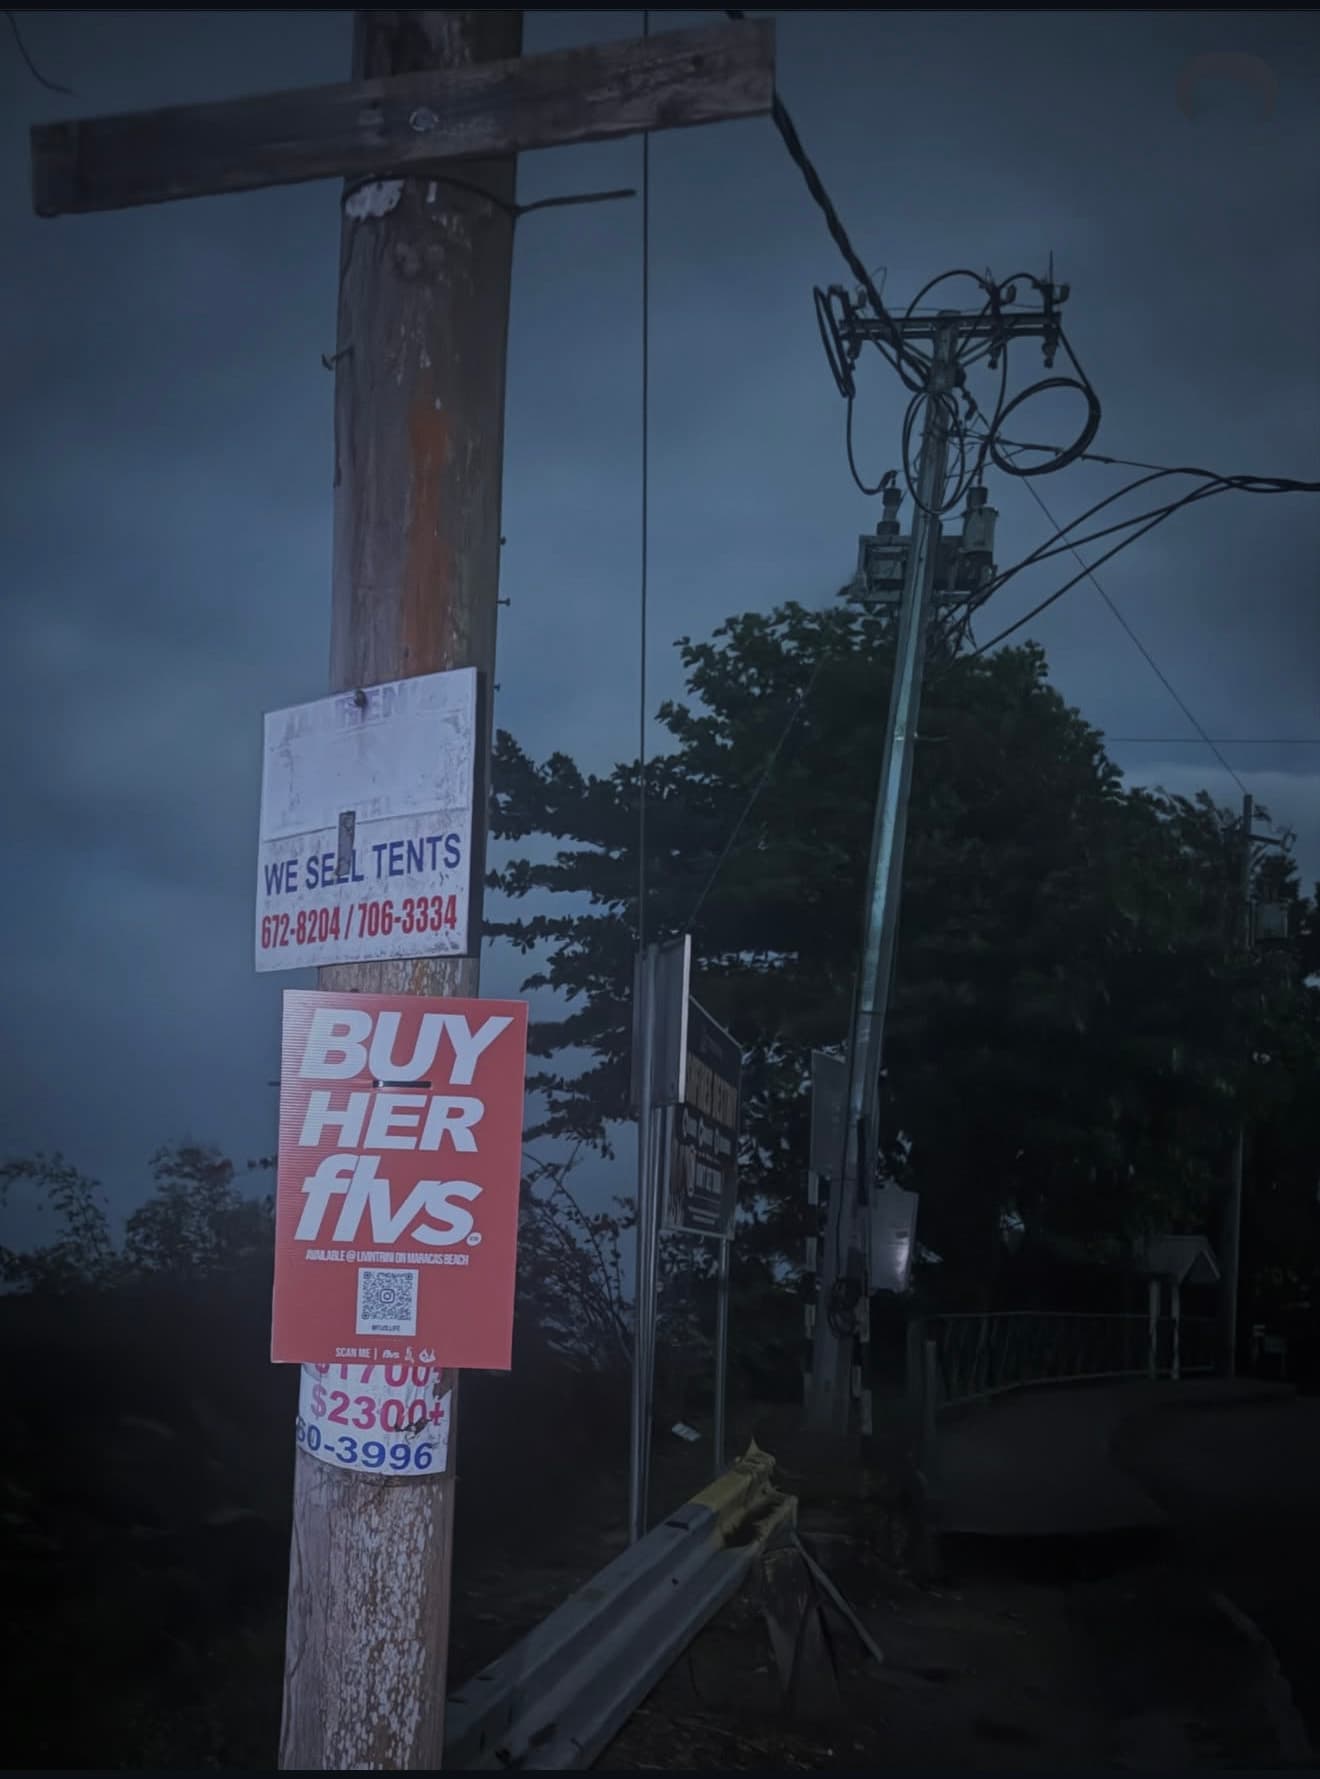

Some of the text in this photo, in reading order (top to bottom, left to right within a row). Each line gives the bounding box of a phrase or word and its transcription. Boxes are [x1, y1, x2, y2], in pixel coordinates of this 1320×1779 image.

[264, 859, 298, 896] WE
[372, 833, 461, 878] TENTS
[261, 906, 341, 949] 672-8204
[358, 895, 457, 938] 706-3334
[298, 1008, 515, 1086] BUY
[298, 1090, 486, 1153] HER
[305, 1249, 346, 1262] AVAILABLE
[444, 1253, 470, 1266] BEACH
[335, 1347, 357, 1358] SCAN
